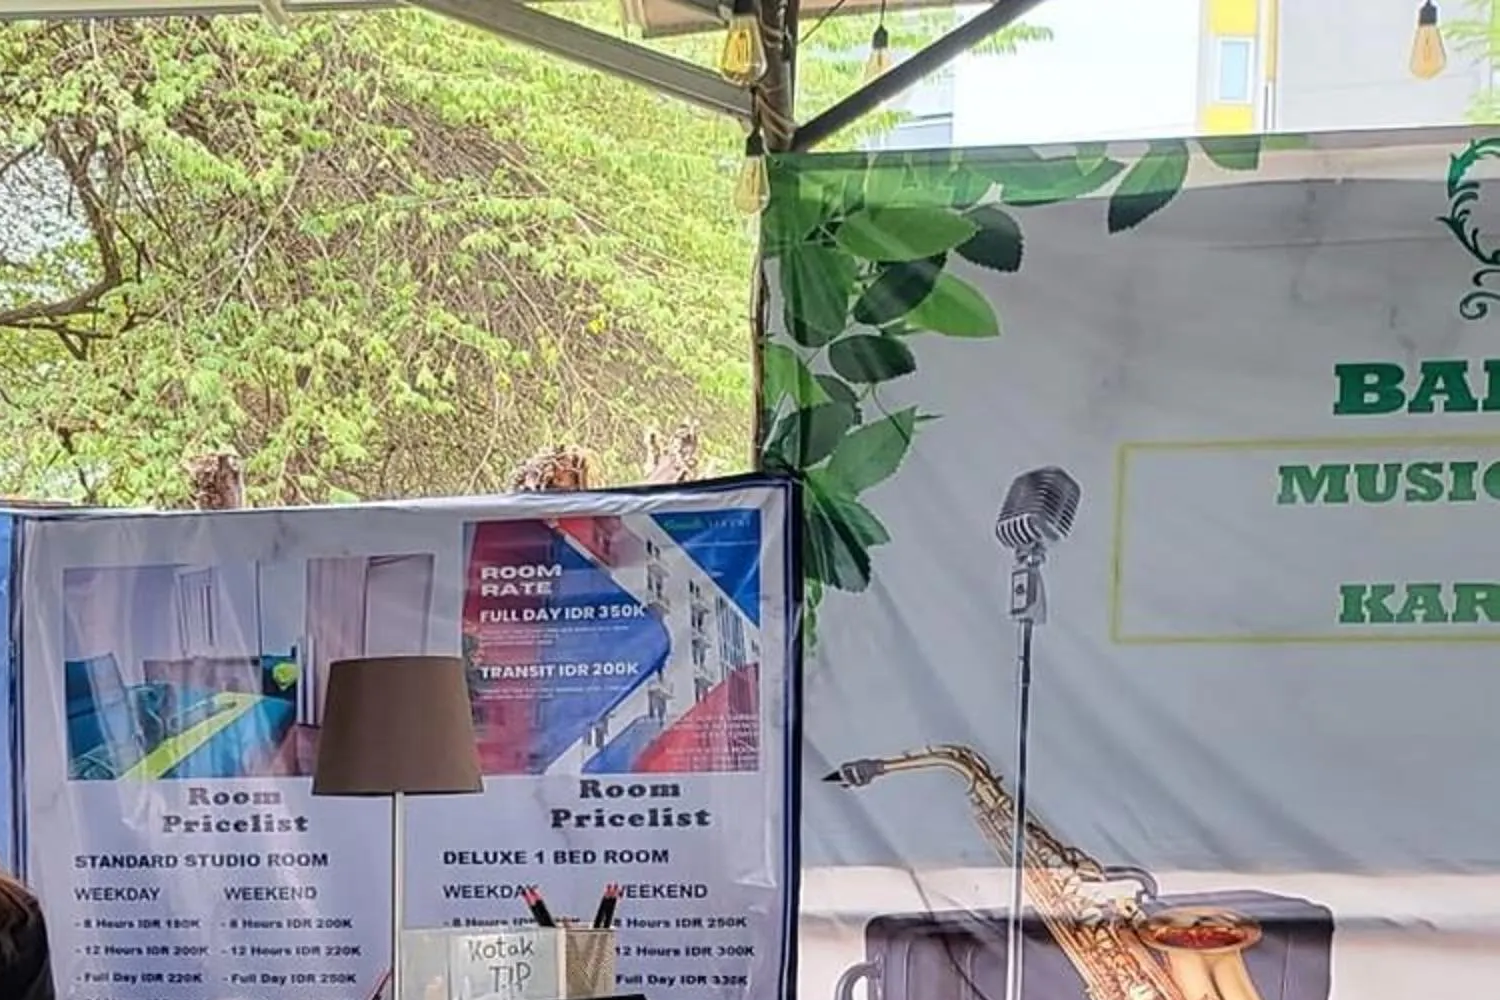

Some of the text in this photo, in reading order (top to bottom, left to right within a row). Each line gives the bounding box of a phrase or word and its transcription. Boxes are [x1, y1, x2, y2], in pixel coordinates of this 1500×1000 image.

[480, 563, 562, 581] ROOM
[480, 581, 554, 597] RATE
[480, 604, 647, 623] FULL DAY IDR 350K
[480, 662, 640, 680] TRANSIT IDR 200K
[187, 787, 282, 806] Room
[579, 779, 681, 799] Room
[162, 814, 310, 834] Pricelist
[551, 808, 713, 829] Pricelist
[74, 852, 329, 869] STANDARD STUDIO ROOM
[443, 849, 669, 865] DELUXE 1 BED ROOM
[73, 887, 161, 901] WEEKDAY
[223, 886, 318, 900] WEEKEND
[96, 919, 135, 929] Hours
[138, 919, 161, 929] IDR
[241, 919, 283, 929] Hours
[286, 919, 312, 929] IDR
[316, 918, 353, 929] 200K
[626, 917, 671, 929] Hours
[675, 917, 704, 929] IDR
[104, 945, 143, 955] Hours
[146, 945, 170, 955] IDR
[250, 945, 292, 956] Hours
[295, 945, 321, 956] IDR
[468, 936, 536, 962] Kotak
[635, 945, 681, 957] Hours
[685, 945, 713, 957] IDR
[112, 973, 138, 985] Day
[141, 973, 164, 983] IDR
[231, 973, 257, 984] Full
[260, 973, 287, 986] Day
[290, 973, 316, 984] IDR
[489, 960, 532, 993] TIP
[615, 974, 643, 985] Full
[647, 974, 676, 987] Day
[680, 974, 708, 985] IDR
